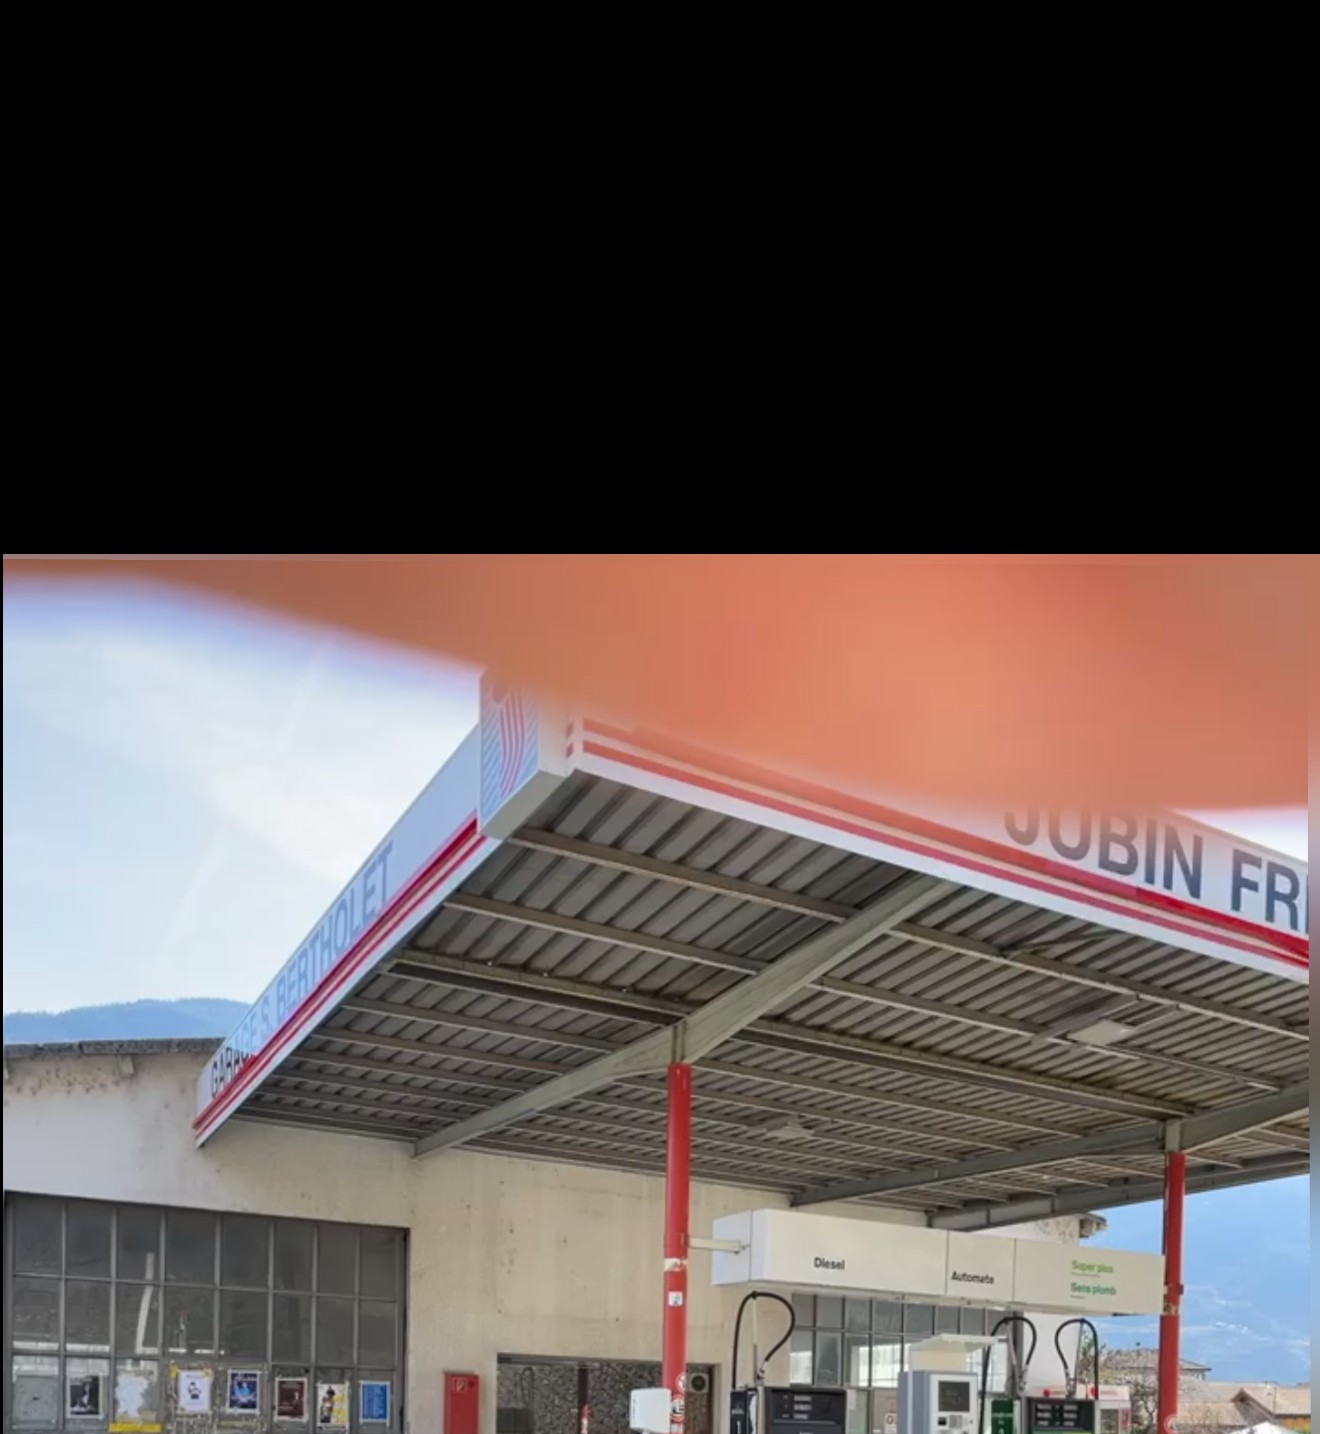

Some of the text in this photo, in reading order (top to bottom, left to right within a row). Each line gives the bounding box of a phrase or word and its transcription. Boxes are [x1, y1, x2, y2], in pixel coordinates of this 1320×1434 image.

[1231, 848, 1309, 936] FR
[277, 839, 394, 1026] BERTHOLET
[813, 1256, 846, 1271] Diesel
[1071, 1259, 1096, 1273] Super
[950, 1270, 995, 1285] Automate
[1070, 1281, 1117, 1297] Sans plomb
